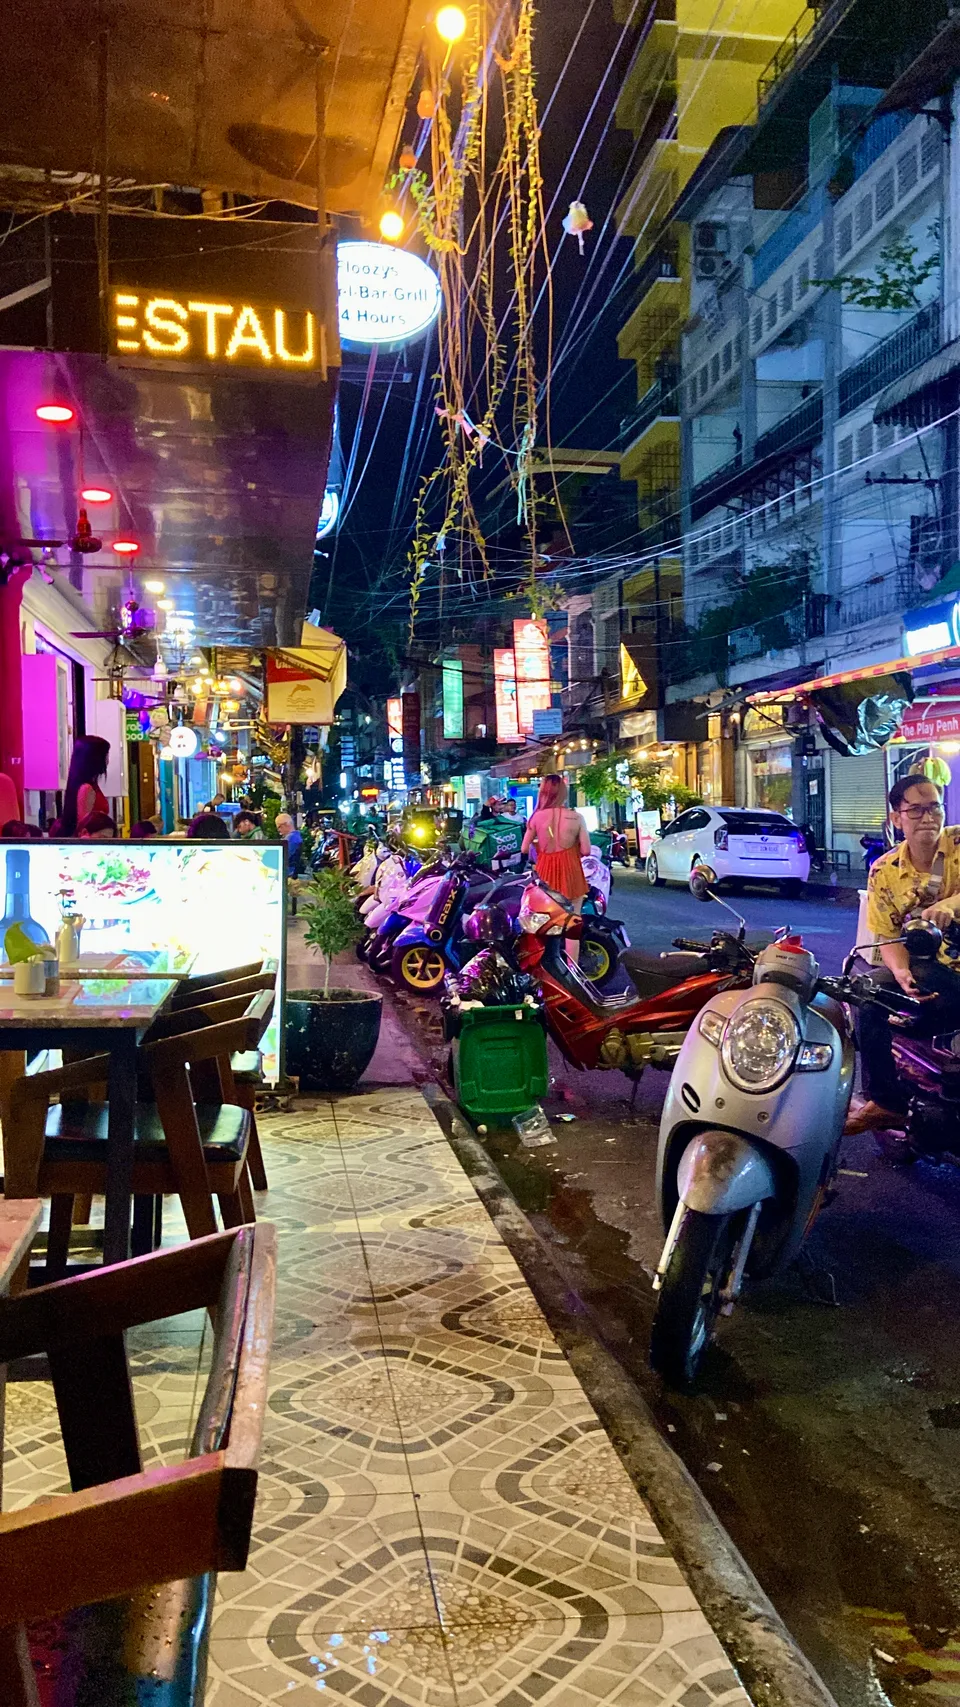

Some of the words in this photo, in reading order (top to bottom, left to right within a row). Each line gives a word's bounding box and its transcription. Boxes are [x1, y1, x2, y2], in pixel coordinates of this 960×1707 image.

[357, 310, 406, 325] Hours
[116, 294, 315, 364] ESTAU
[900, 724, 915, 737] The
[916, 721, 935, 736] Play
[936, 716, 959, 733] Penh
[496, 840, 518, 852] Food
